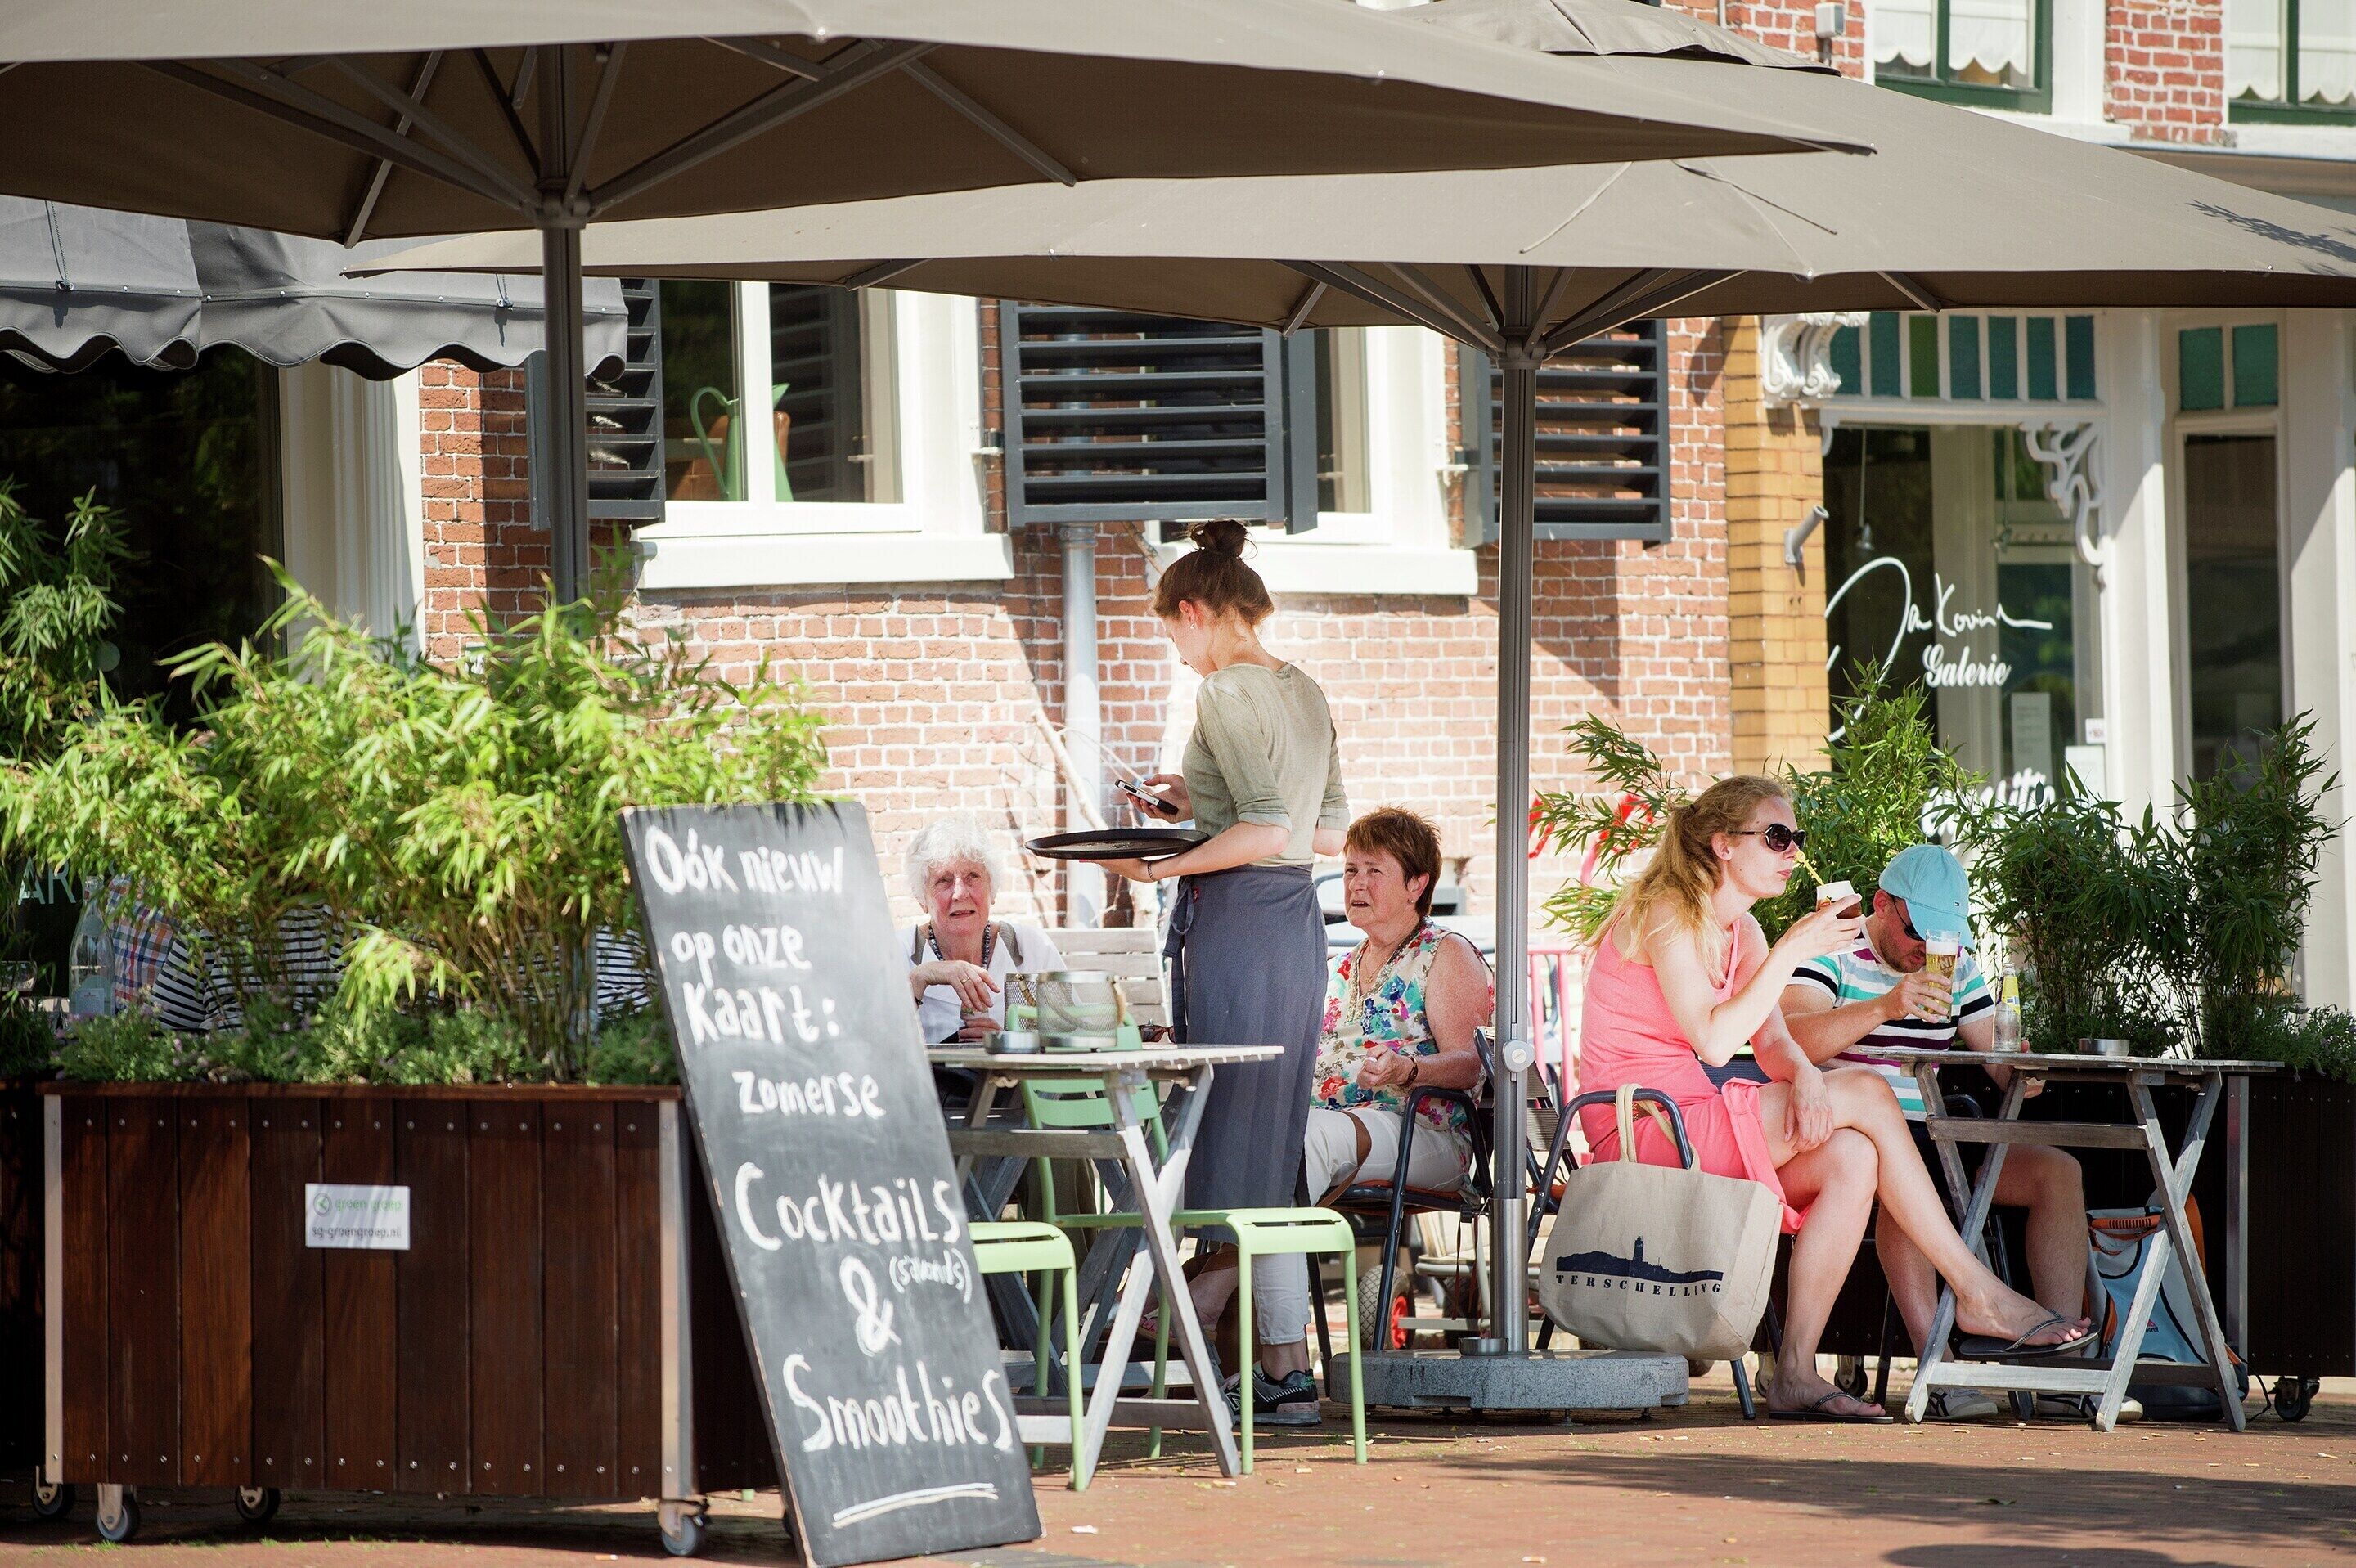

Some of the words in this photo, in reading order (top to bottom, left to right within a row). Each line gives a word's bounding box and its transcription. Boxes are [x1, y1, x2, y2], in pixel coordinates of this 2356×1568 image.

[1922, 643, 2012, 688] Galerie
[738, 845, 844, 894] nieuw
[670, 930, 716, 991] op
[722, 923, 813, 971] onze
[839, 1255, 902, 1358] &
[1555, 1274, 1722, 1296] TERSCHELLING
[782, 1352, 1013, 1452] Smoothies
